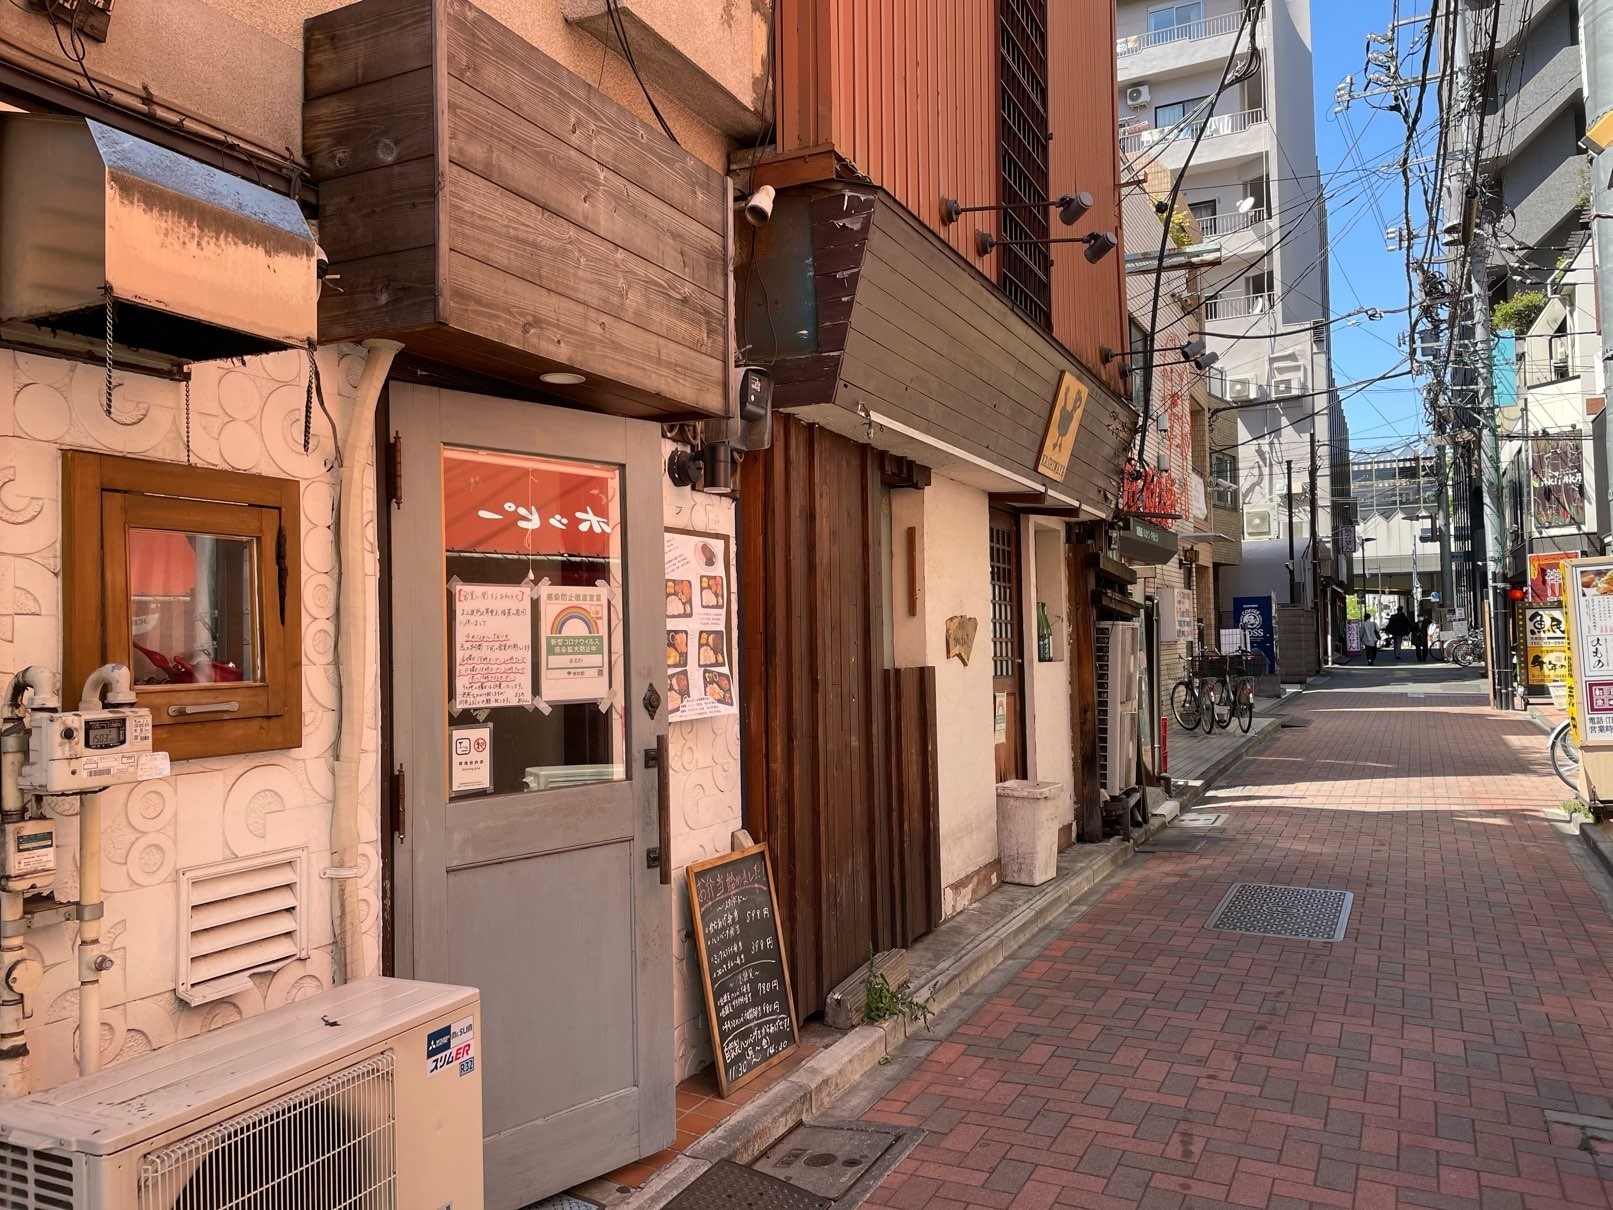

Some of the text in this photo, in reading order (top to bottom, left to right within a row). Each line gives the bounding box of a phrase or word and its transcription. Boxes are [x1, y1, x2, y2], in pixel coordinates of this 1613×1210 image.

[1245, 628, 1264, 637] OSS
[1347, 624, 1356, 650] 処方せん
[550, 638, 600, 646] 新型コロナウイルス
[554, 645, 597, 654] 感染拡大防止中
[460, 1060, 473, 1074] R32
